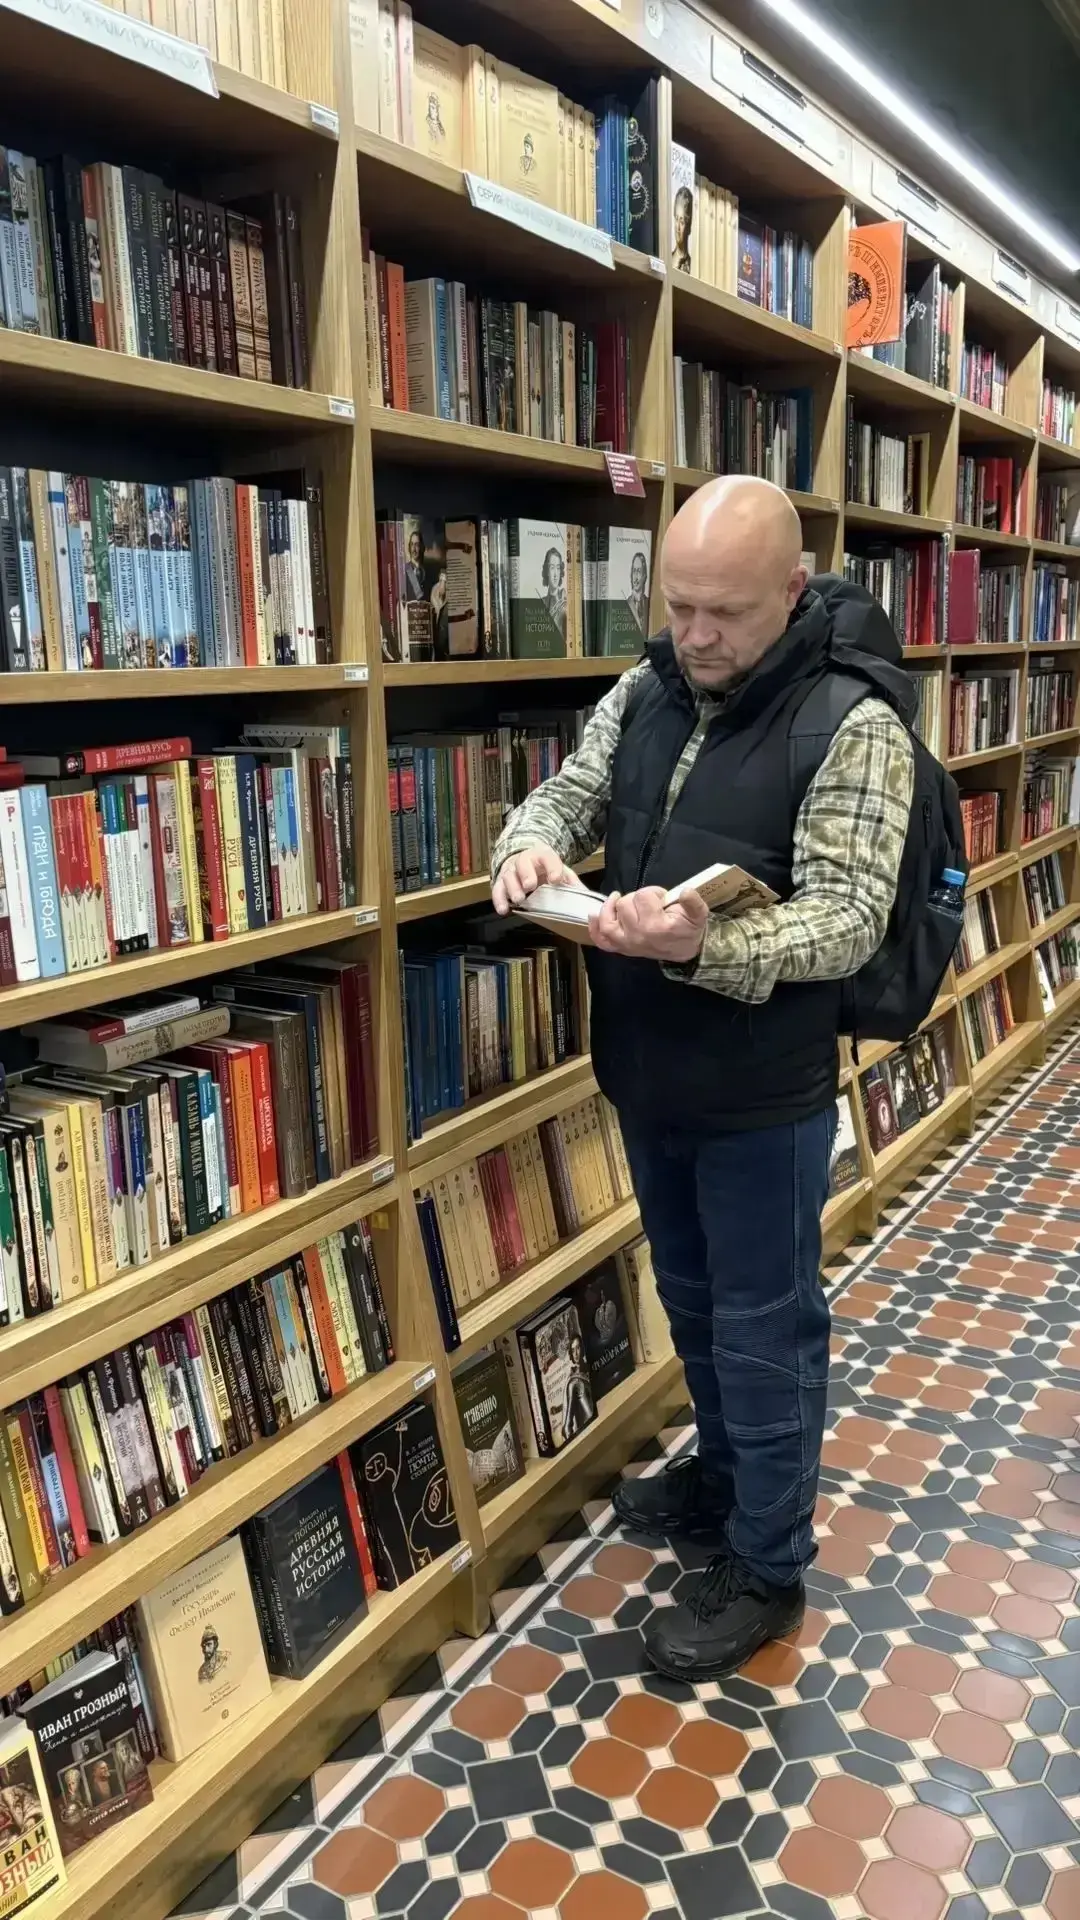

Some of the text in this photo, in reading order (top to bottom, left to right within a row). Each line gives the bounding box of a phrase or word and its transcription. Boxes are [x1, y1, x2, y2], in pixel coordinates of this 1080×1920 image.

[136, 267, 147, 314] ИСТОРИЯ
[141, 246, 155, 337] ДРЕВНЯЯ РУССКАЯ
[227, 838, 238, 869] РУСИ
[248, 835, 262, 911] ДРЕВНЯЯ РУСЬ
[39, 885, 58, 940] ГОРОДА
[186, 1092, 199, 1130] КАЗАНЬ
[190, 1139, 203, 1177] МОСКВА
[105, 1361, 118, 1409] И.Я. Фроянов
[125, 1368, 137, 1398] Фроянов
[219, 1338, 238, 1398] ЦАРЬ-МОНАХ
[250, 1347, 273, 1424] БОРИС ГОДУНОВ
[115, 1423, 127, 1458] ИСТОРИИ
[408, 1451, 437, 1474] ПОЧТА
[134, 1495, 143, 1505] 2
[290, 1515, 340, 1568] ДРЕВНЯЯ
[294, 1510, 328, 1542] ПОГОДИН
[292, 1530, 343, 1582] РУССКАЯ
[295, 1546, 347, 1597] ИСТОРИЯ
[168, 1590, 237, 1638] Федор Иванович
[180, 1587, 220, 1617] Государь
[271, 1576, 291, 1648] ДРЕВНЯЯ РУССКАЯ
[38, 1682, 128, 1743] ИВАН ГРОЗНЫЙ
[89, 1799, 130, 1826] СЕРГЕЙ НЕЧАЕВ
[0, 1837, 55, 1896] ЗНЫЙ
[3, 1826, 47, 1867] ВАН
